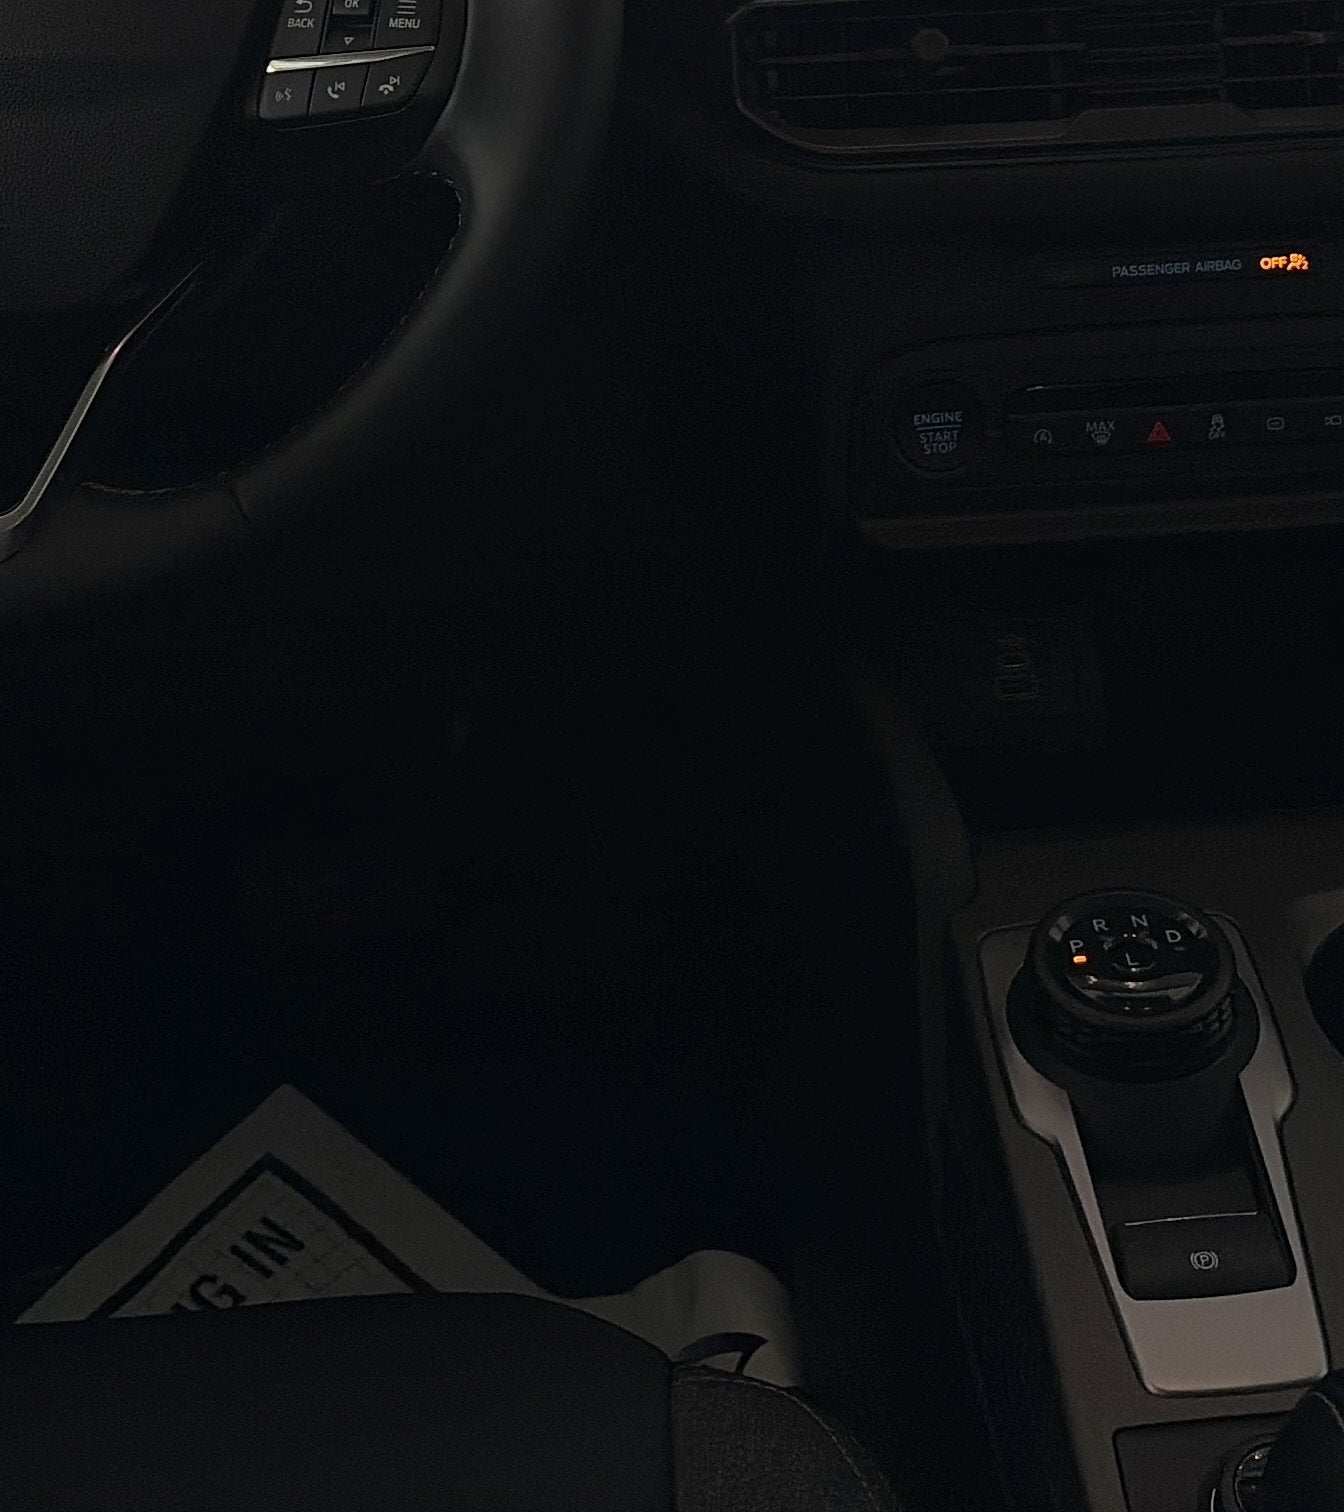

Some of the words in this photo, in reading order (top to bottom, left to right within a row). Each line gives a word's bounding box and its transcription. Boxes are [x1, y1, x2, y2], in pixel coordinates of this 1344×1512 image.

[287, 18, 315, 28] BACK
[388, 18, 421, 29] MENU
[1112, 262, 1190, 278] PASSENGER
[1195, 258, 1242, 273] AIRBAG
[1260, 256, 1287, 270] OFF
[913, 411, 963, 425] ENGINE
[1085, 420, 1116, 433] MAX
[920, 430, 959, 444] START
[923, 442, 957, 455] STOP
[1092, 918, 1110, 932] R
[1130, 914, 1149, 929] N
[1166, 929, 1183, 943] D
[1069, 939, 1086, 954] P
[229, 1216, 305, 1279] IN
